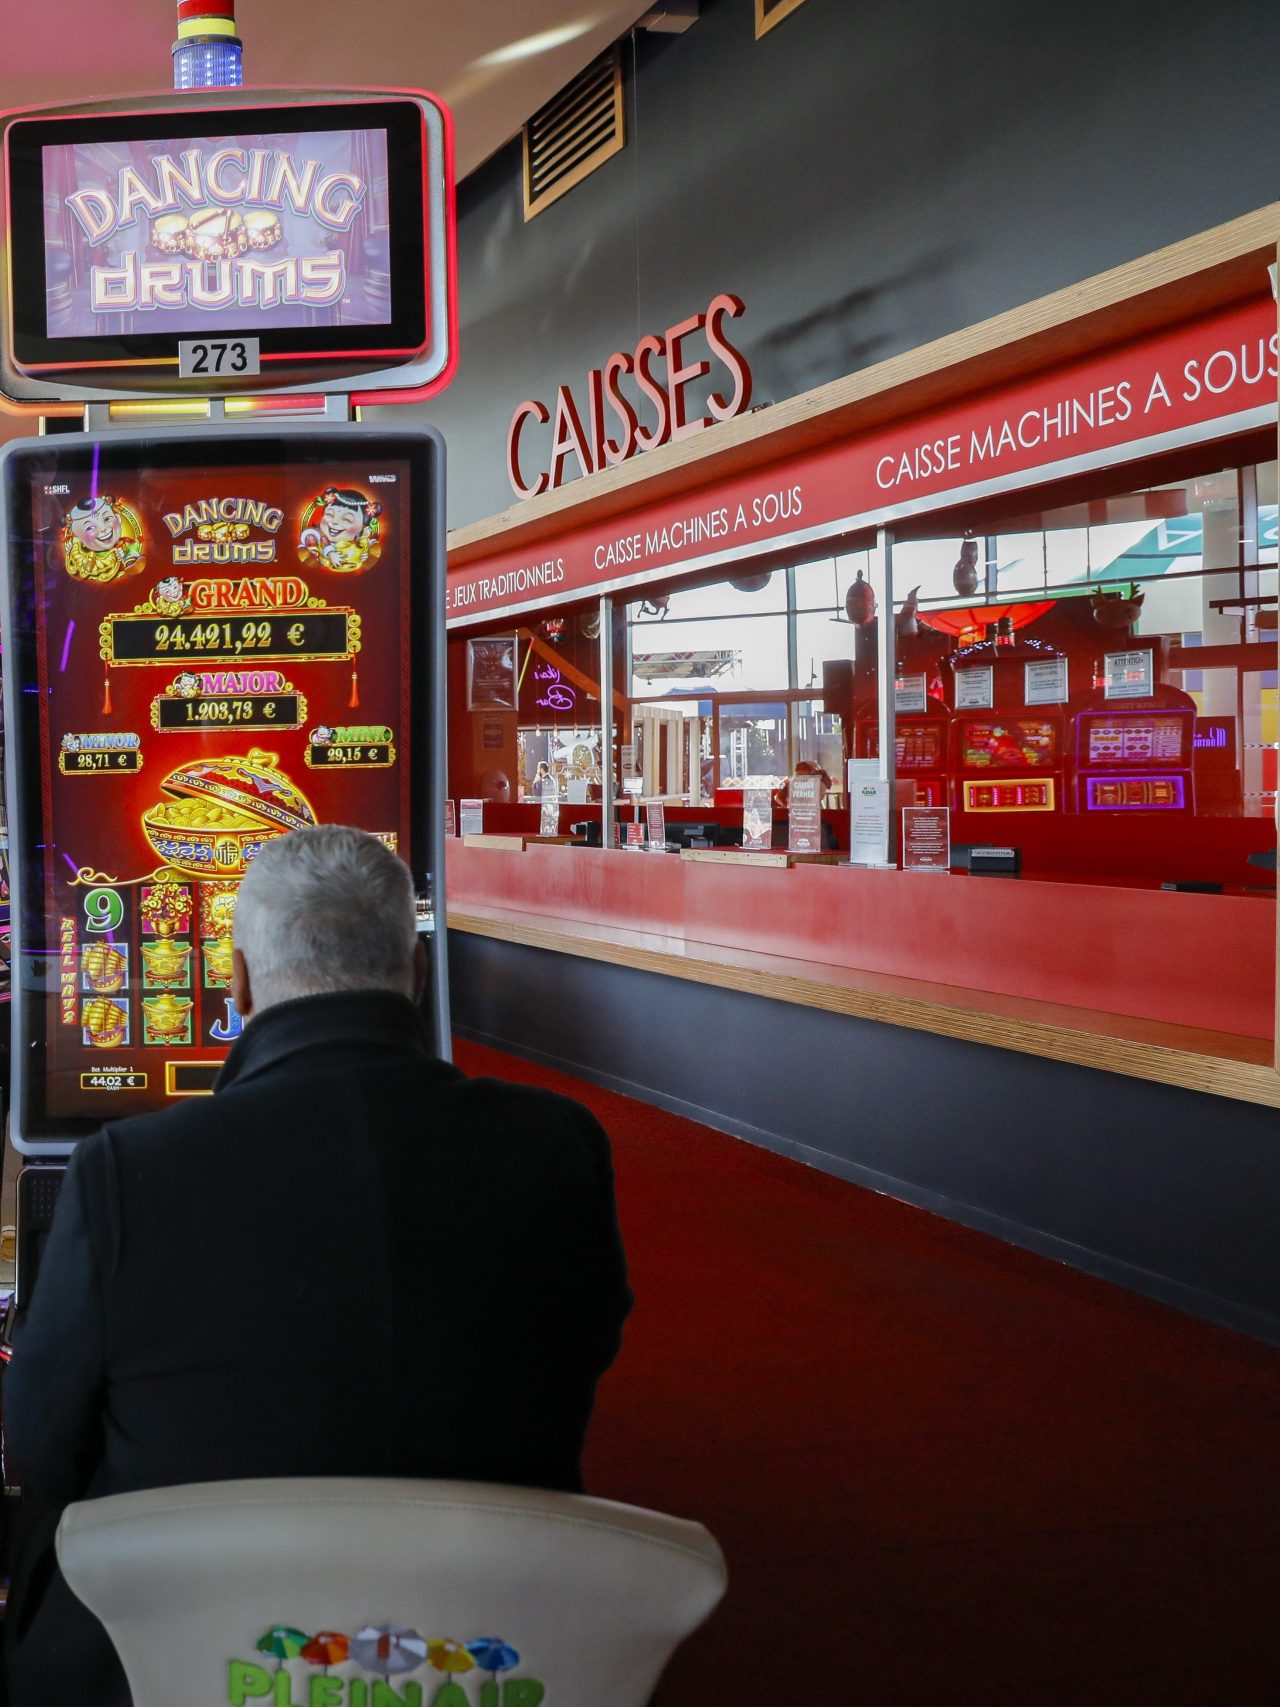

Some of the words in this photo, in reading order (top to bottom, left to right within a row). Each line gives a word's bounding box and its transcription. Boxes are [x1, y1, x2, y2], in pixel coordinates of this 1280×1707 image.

[66, 149, 367, 247] DANCING
[191, 343, 248, 373] 273
[506, 294, 752, 500] CAISSES
[875, 434, 961, 489] CAISSE
[969, 382, 1132, 463] MACHINES
[1143, 371, 1172, 414] A
[1182, 334, 1279, 401] SOUS
[163, 497, 285, 537] DANCING
[453, 582, 476, 608] JEUX
[478, 558, 564, 601] TRADITIONNELS
[594, 534, 641, 570] CAISSE
[646, 508, 729, 556] MACHINES
[734, 504, 747, 532] A
[753, 486, 802, 527] SOUS
[190, 577, 307, 609] GRAND
[154, 622, 272, 654] 24.421,22
[287, 623, 305, 646] €
[200, 671, 281, 694] MAJOR
[186, 701, 253, 724] 1.203,73
[263, 702, 276, 719] €
[81, 734, 138, 749] MINOR
[336, 727, 387, 744] MINI
[77, 754, 110, 769] 28,71
[117, 754, 127, 767] €
[327, 747, 361, 763] 29,15
[368, 747, 378, 760] €
[84, 888, 124, 933] 9
[61, 918, 75, 966] REEL
[60, 972, 76, 1024] WAYS
[127, 1076, 135, 1087] €
[226, 1659, 527, 1707] PLEINAIR
